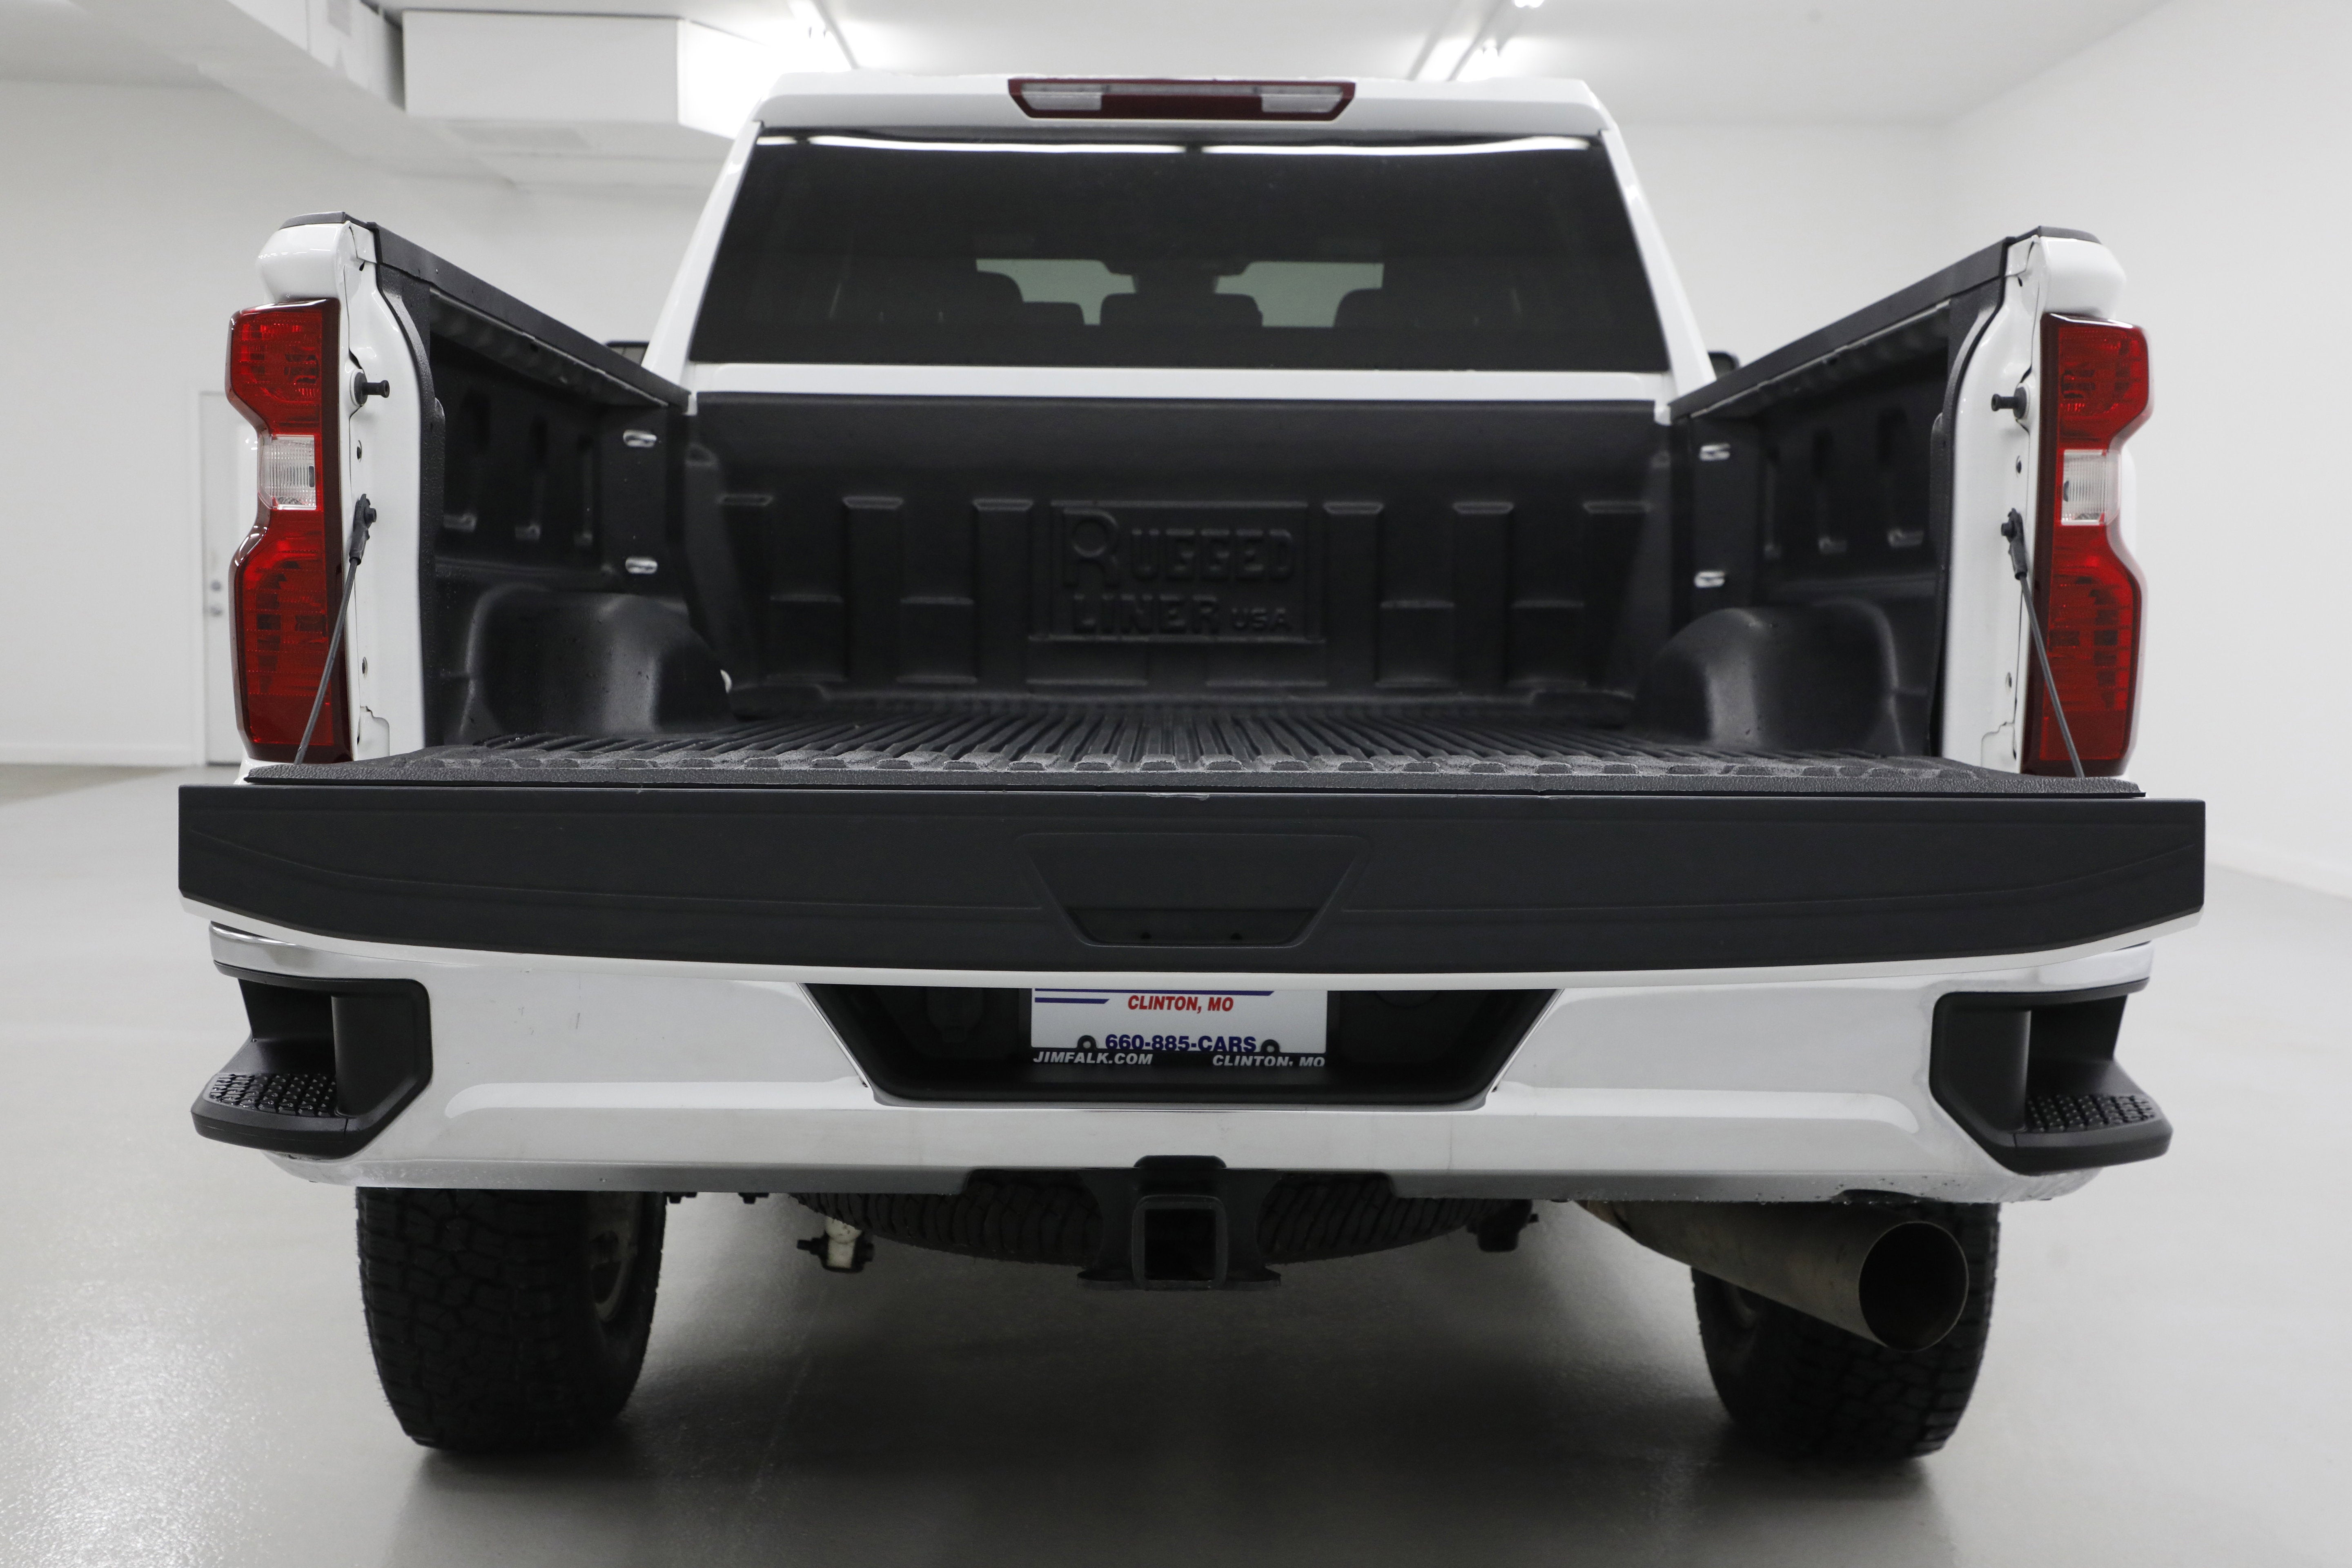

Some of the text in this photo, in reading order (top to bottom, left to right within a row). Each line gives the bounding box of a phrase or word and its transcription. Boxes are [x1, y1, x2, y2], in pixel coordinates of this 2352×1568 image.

[1062, 507, 1294, 587] RUGGED
[1074, 593, 1293, 633] LINER USA
[1127, 995, 1234, 1014] CLINTON, MO
[1105, 1033, 1257, 1053] 660-885-CARS
[1033, 1051, 1153, 1065] JIMFALK.COM
[1212, 1055, 1325, 1067] CLINTON, MO
